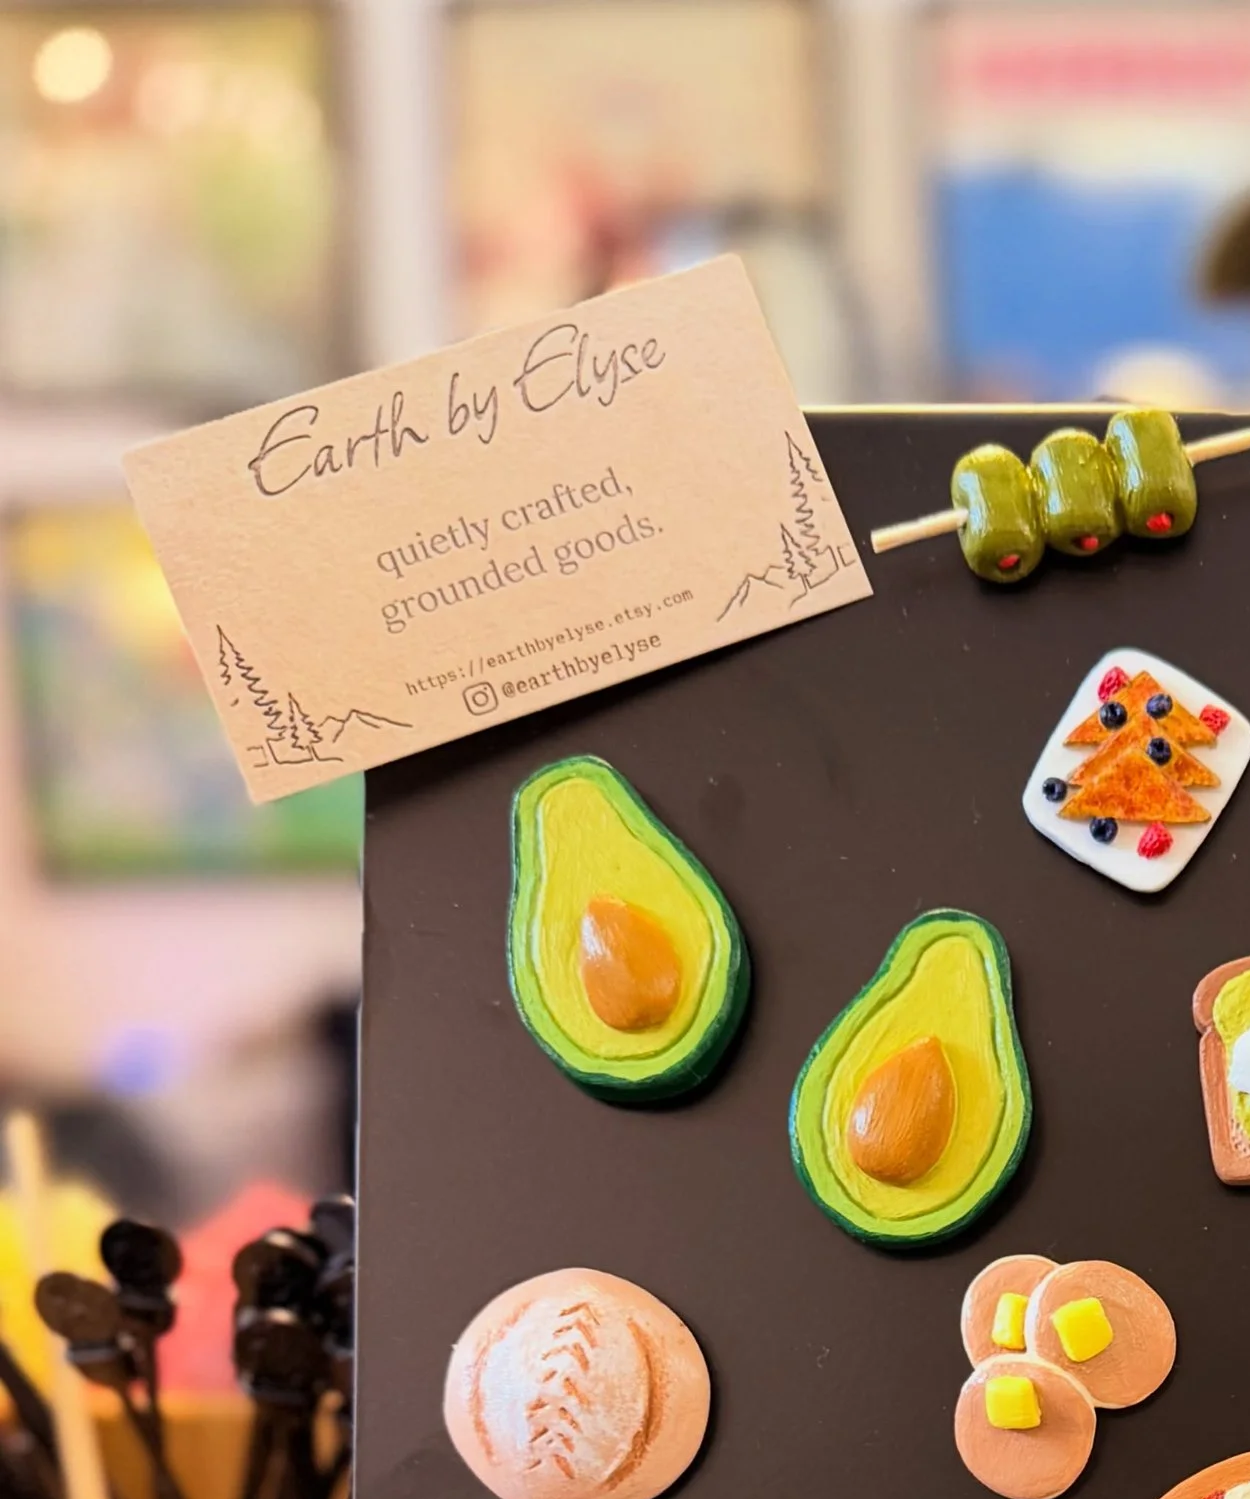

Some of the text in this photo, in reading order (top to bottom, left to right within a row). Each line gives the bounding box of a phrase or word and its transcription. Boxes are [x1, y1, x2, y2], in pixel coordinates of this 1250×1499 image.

[248, 324, 666, 497] Earth by Elyse
[376, 467, 634, 580] quietly crafted,
[380, 517, 665, 635] grounded goods.
[405, 588, 694, 696] https://earthbyelyse.etsy.com
[501, 633, 663, 698] @earthbyelyse
